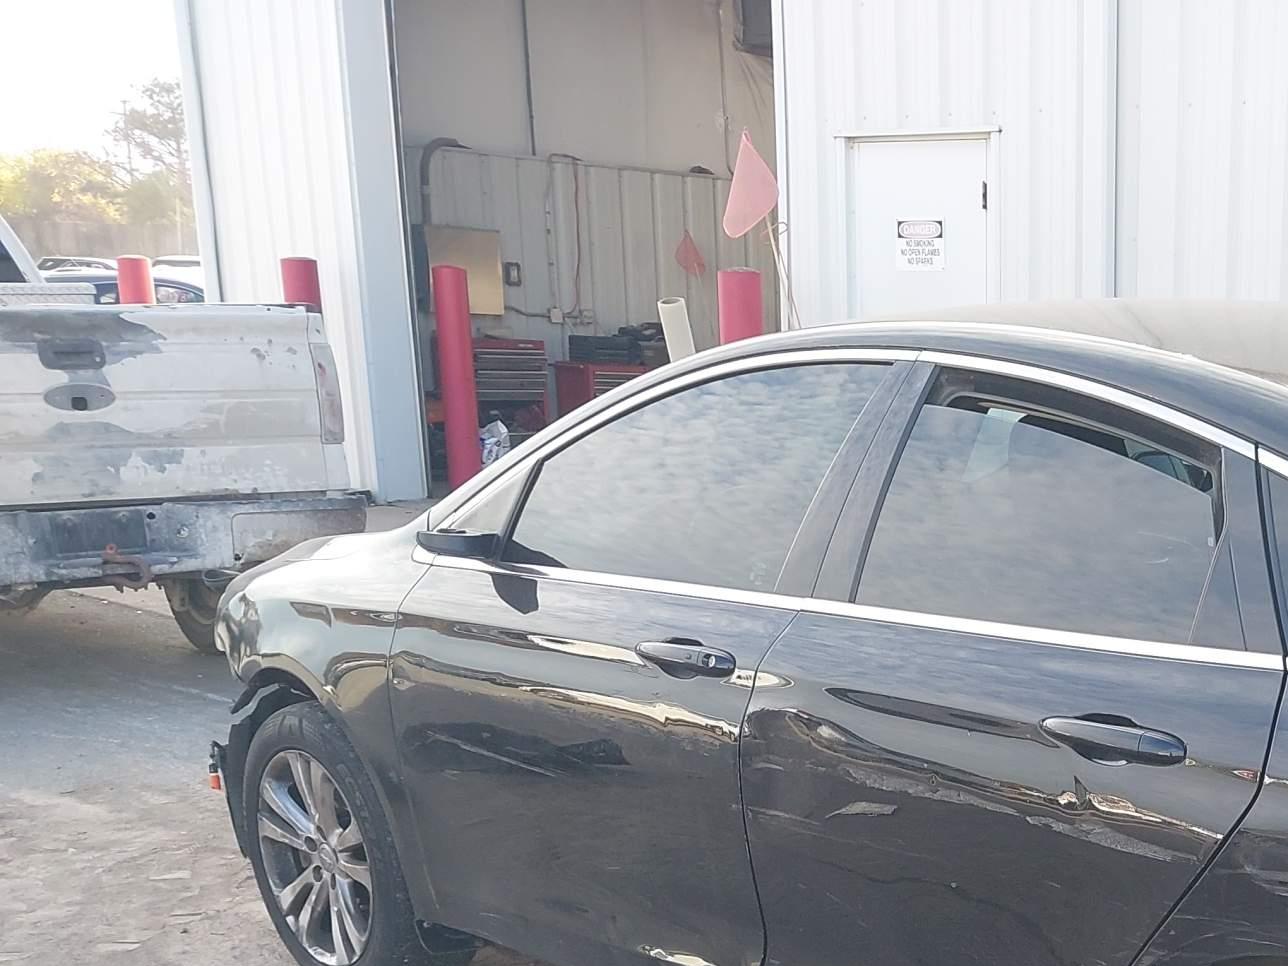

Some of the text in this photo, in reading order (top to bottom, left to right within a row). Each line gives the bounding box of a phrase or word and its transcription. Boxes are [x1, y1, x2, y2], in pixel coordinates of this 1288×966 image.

[903, 223, 937, 235] DANGER
[905, 239, 912, 247] NO
[901, 248, 940, 256] NO OPEN FLAMES
[907, 257, 914, 265] NO
